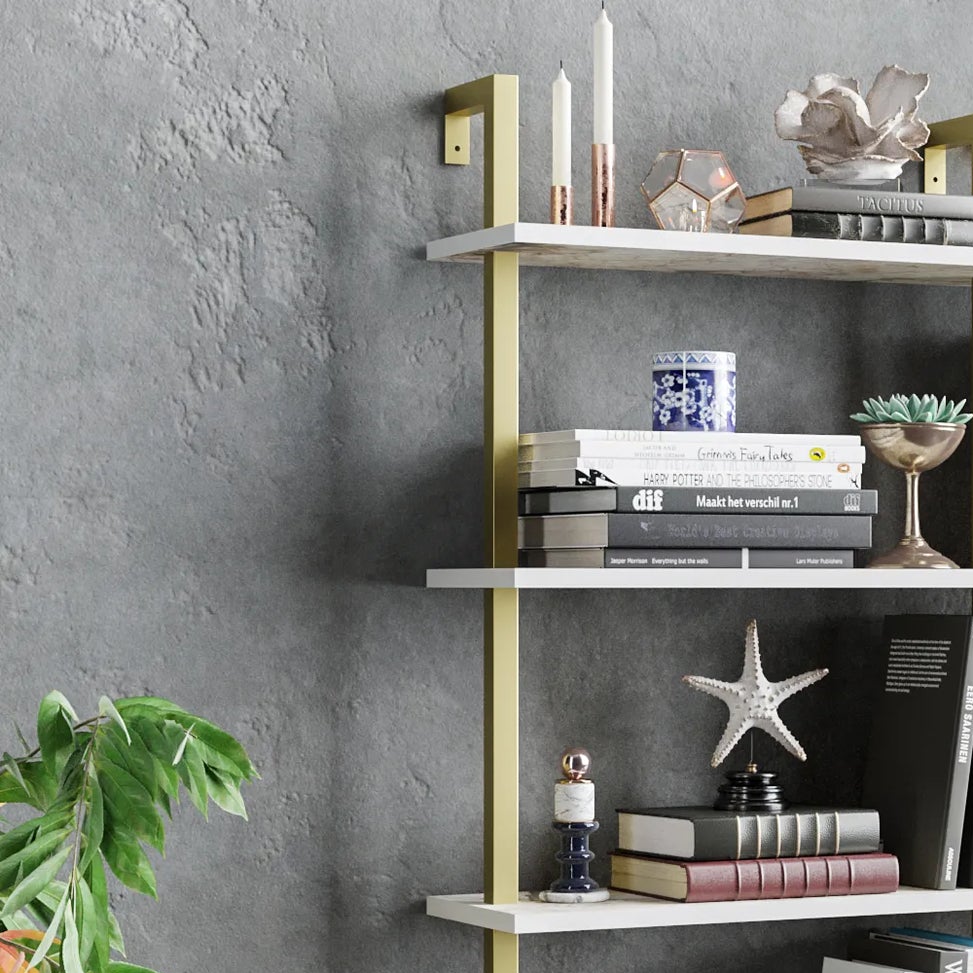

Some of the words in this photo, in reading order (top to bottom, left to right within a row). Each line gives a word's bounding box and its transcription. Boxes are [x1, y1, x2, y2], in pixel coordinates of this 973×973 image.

[857, 195, 924, 213] TACITUS
[763, 444, 793, 462] Tales
[643, 472, 670, 486] HARRY
[672, 473, 704, 487] POTTER
[707, 473, 724, 487] AND
[726, 473, 741, 487] THE
[808, 474, 833, 488] STONE
[632, 489, 664, 511] dif
[696, 495, 726, 508] Maakt
[727, 495, 744, 508] het
[745, 494, 780, 508] verschil
[781, 495, 799, 509] nr.1
[651, 557, 677, 566] Everything
